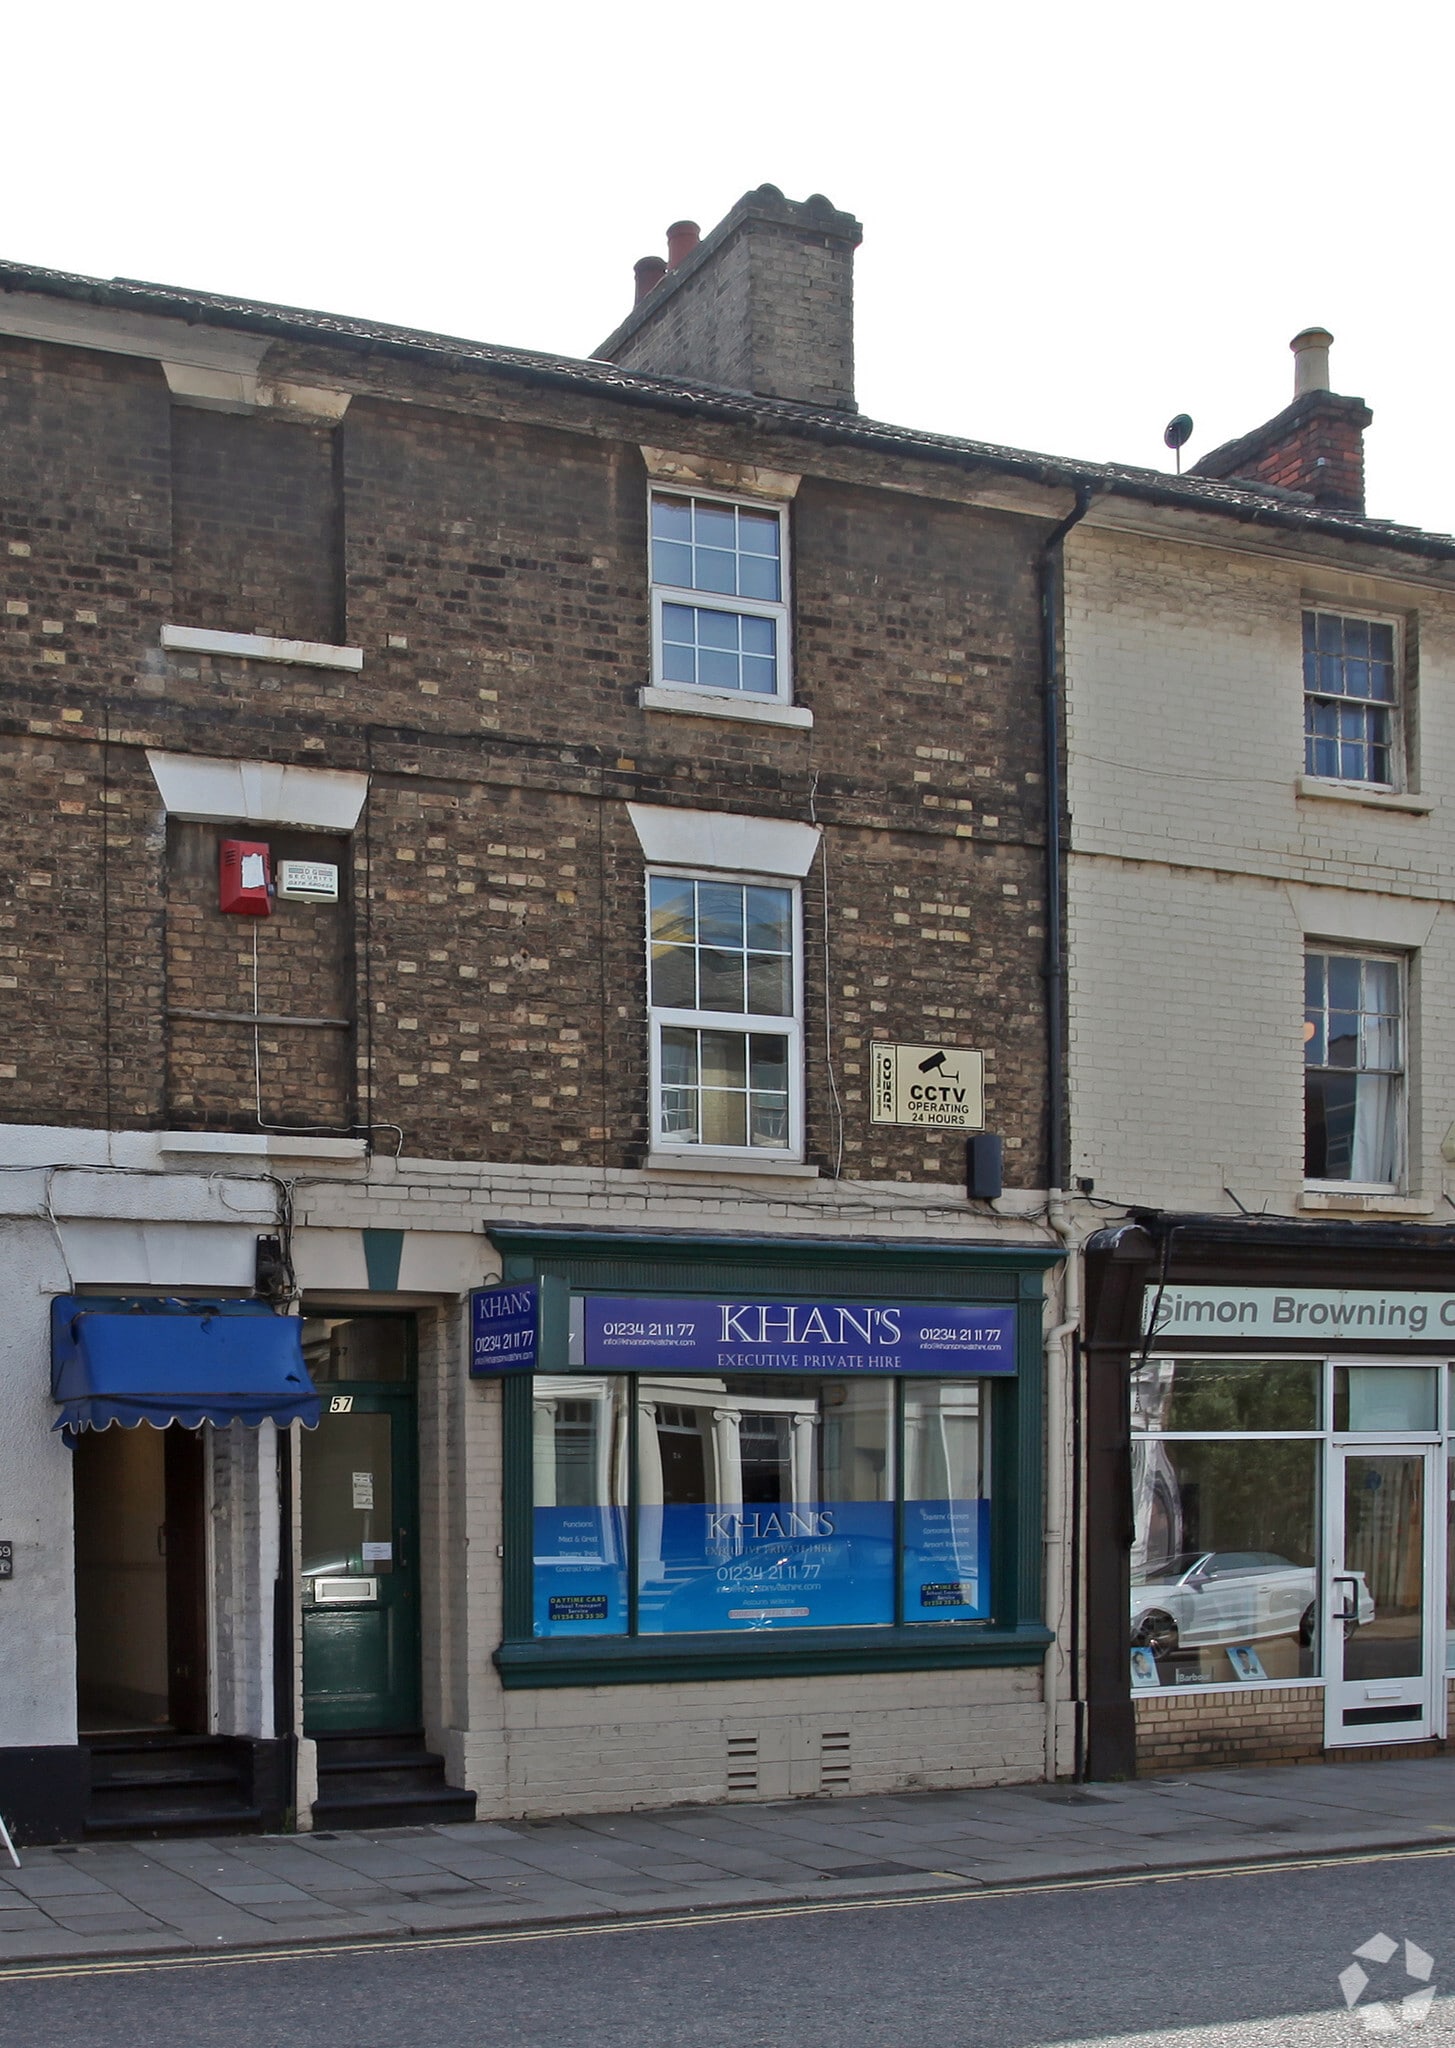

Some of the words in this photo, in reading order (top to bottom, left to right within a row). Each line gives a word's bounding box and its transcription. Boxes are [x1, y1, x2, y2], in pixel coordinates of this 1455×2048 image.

[288, 874, 333, 882] SECURITY
[910, 1085, 966, 1103] CCTV
[907, 1101, 969, 1114] OPERATING
[912, 1112, 924, 1122] 24
[928, 1113, 965, 1125] HOURS
[1151, 1292, 1258, 1323] Simon
[1272, 1296, 1429, 1333] Browning
[603, 1322, 645, 1336] 01234
[648, 1323, 661, 1336] 21
[665, 1323, 673, 1336] 11
[677, 1323, 695, 1336] 77
[716, 1304, 902, 1345] KHAN'S
[919, 1327, 957, 1340] 01234
[959, 1328, 971, 1341] 21
[975, 1329, 982, 1341] 11
[985, 1329, 1001, 1341] 77
[475, 1335, 501, 1353] 01234
[503, 1333, 512, 1349] 21
[514, 1332, 520, 1348] 11
[522, 1330, 534, 1346] 77
[717, 1354, 799, 1367] EXECUTIVE
[804, 1355, 864, 1368] PRIVATE
[868, 1356, 902, 1369] HIRE
[332, 1397, 351, 1411] 57
[0, 1545, 11, 1557] 9
[716, 1566, 763, 1581] 01234
[768, 1565, 782, 1580] 21
[789, 1565, 797, 1579] 11
[801, 1564, 821, 1579] 77
